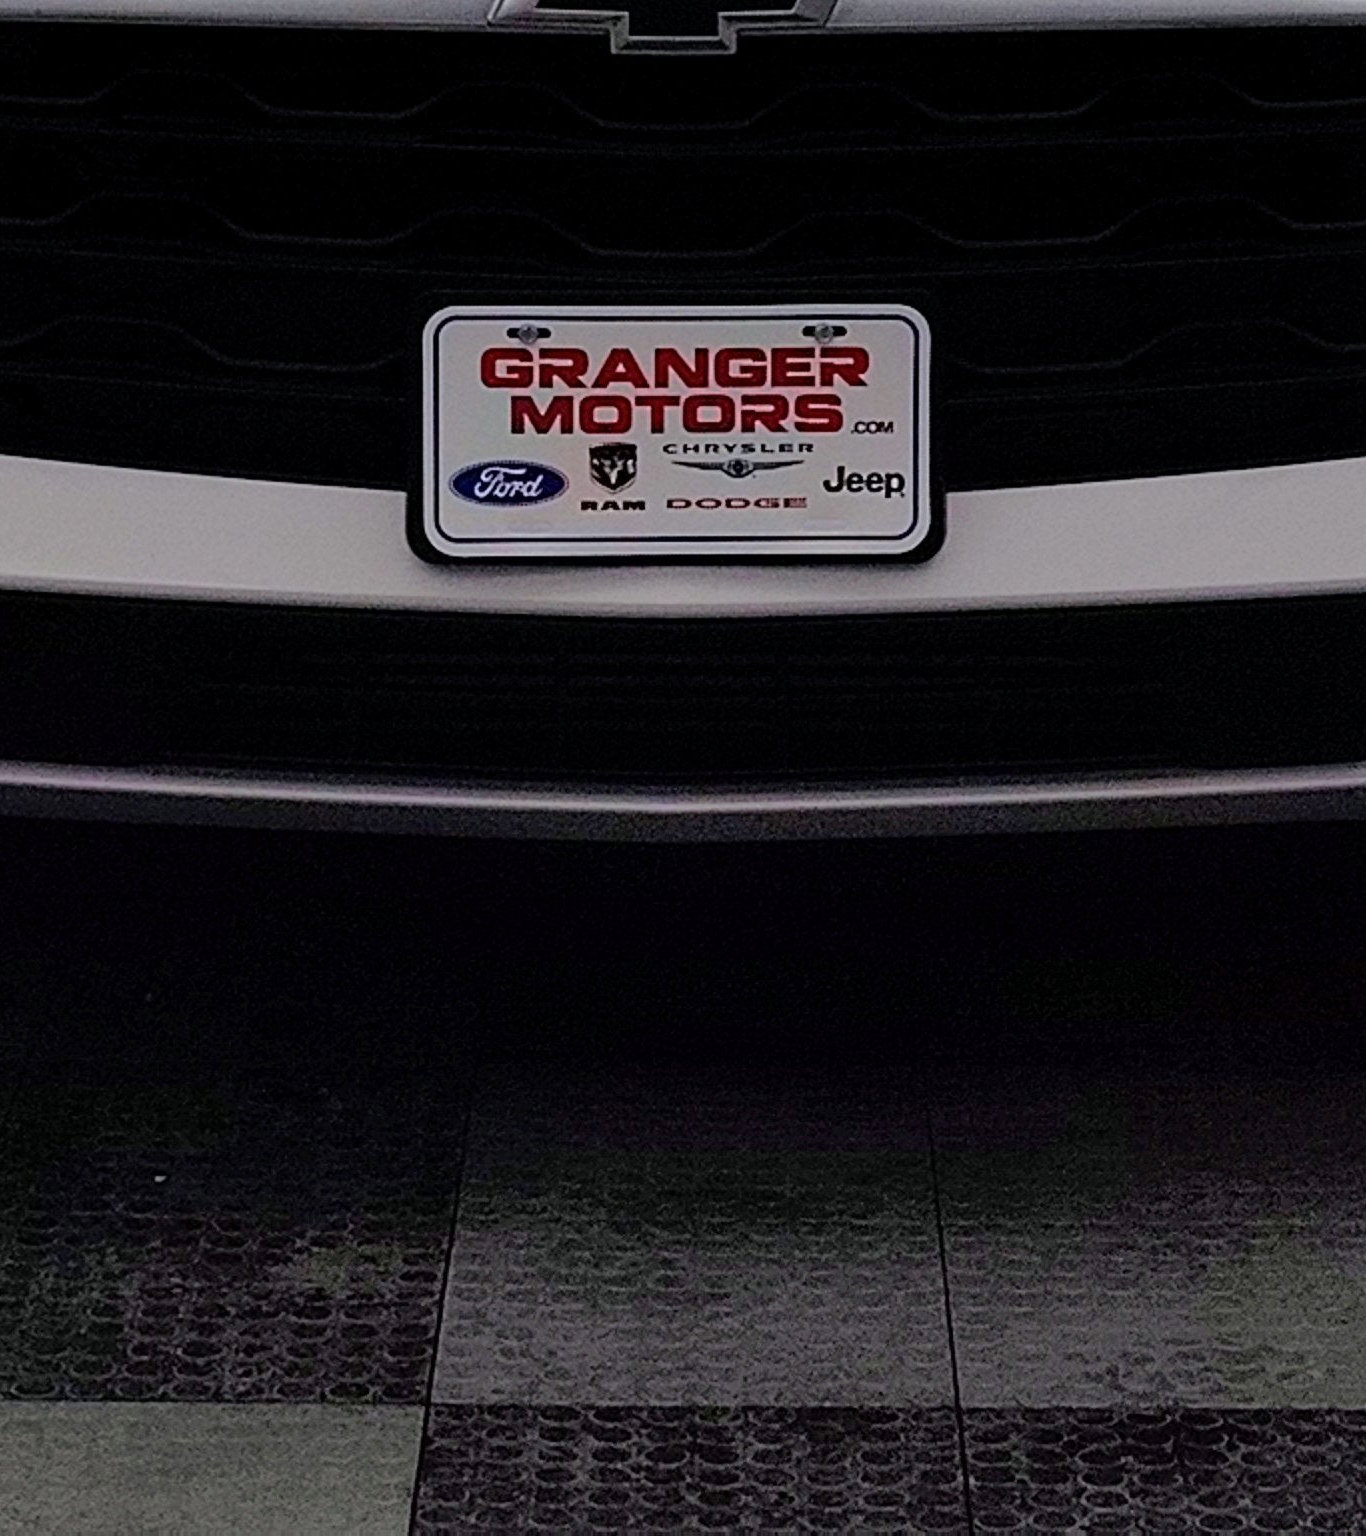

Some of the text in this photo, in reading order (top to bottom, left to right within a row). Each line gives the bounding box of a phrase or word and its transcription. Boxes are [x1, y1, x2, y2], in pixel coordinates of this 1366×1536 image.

[480, 346, 870, 389] GRANGER
[510, 393, 894, 435] MOTORS .COM
[662, 442, 815, 455] CHRYSLER
[473, 470, 544, 500] Ford
[822, 465, 905, 498] Jeep
[580, 500, 646, 511] RAM
[666, 497, 808, 510] DODGE
